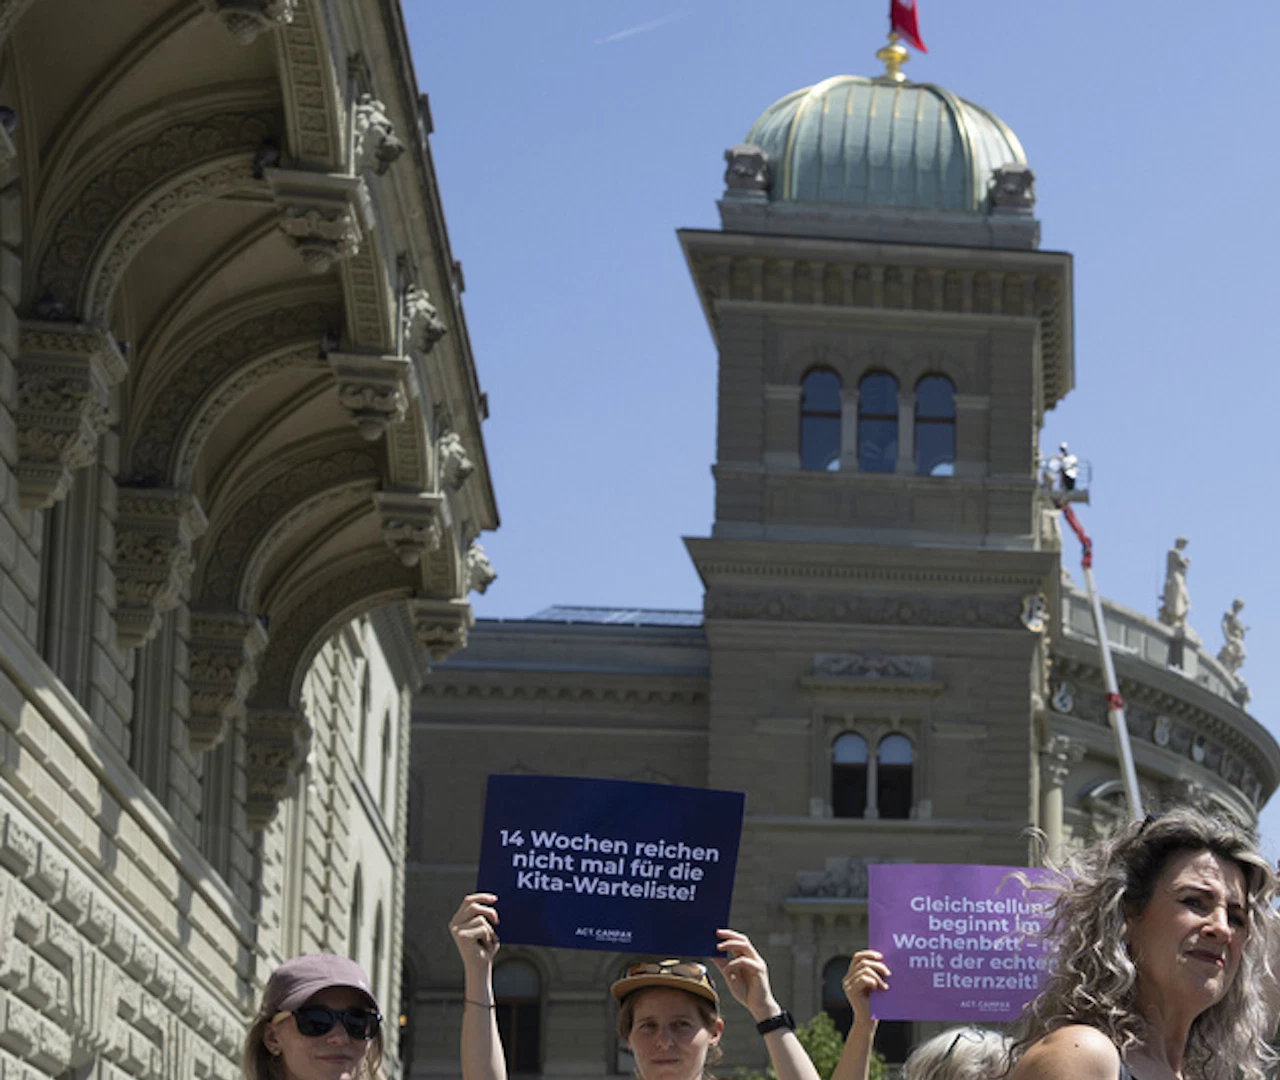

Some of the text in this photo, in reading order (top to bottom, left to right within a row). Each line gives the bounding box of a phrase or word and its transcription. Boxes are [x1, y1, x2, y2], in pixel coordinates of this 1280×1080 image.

[500, 829, 720, 863] 14 Wochen reichen
[512, 850, 704, 882] nicht mal für die
[516, 871, 697, 902] Kita-Warteliste!
[928, 915, 1010, 935] beginnt
[909, 952, 944, 968] mit
[950, 953, 985, 970] der
[933, 972, 1039, 990] Elternzeit!
